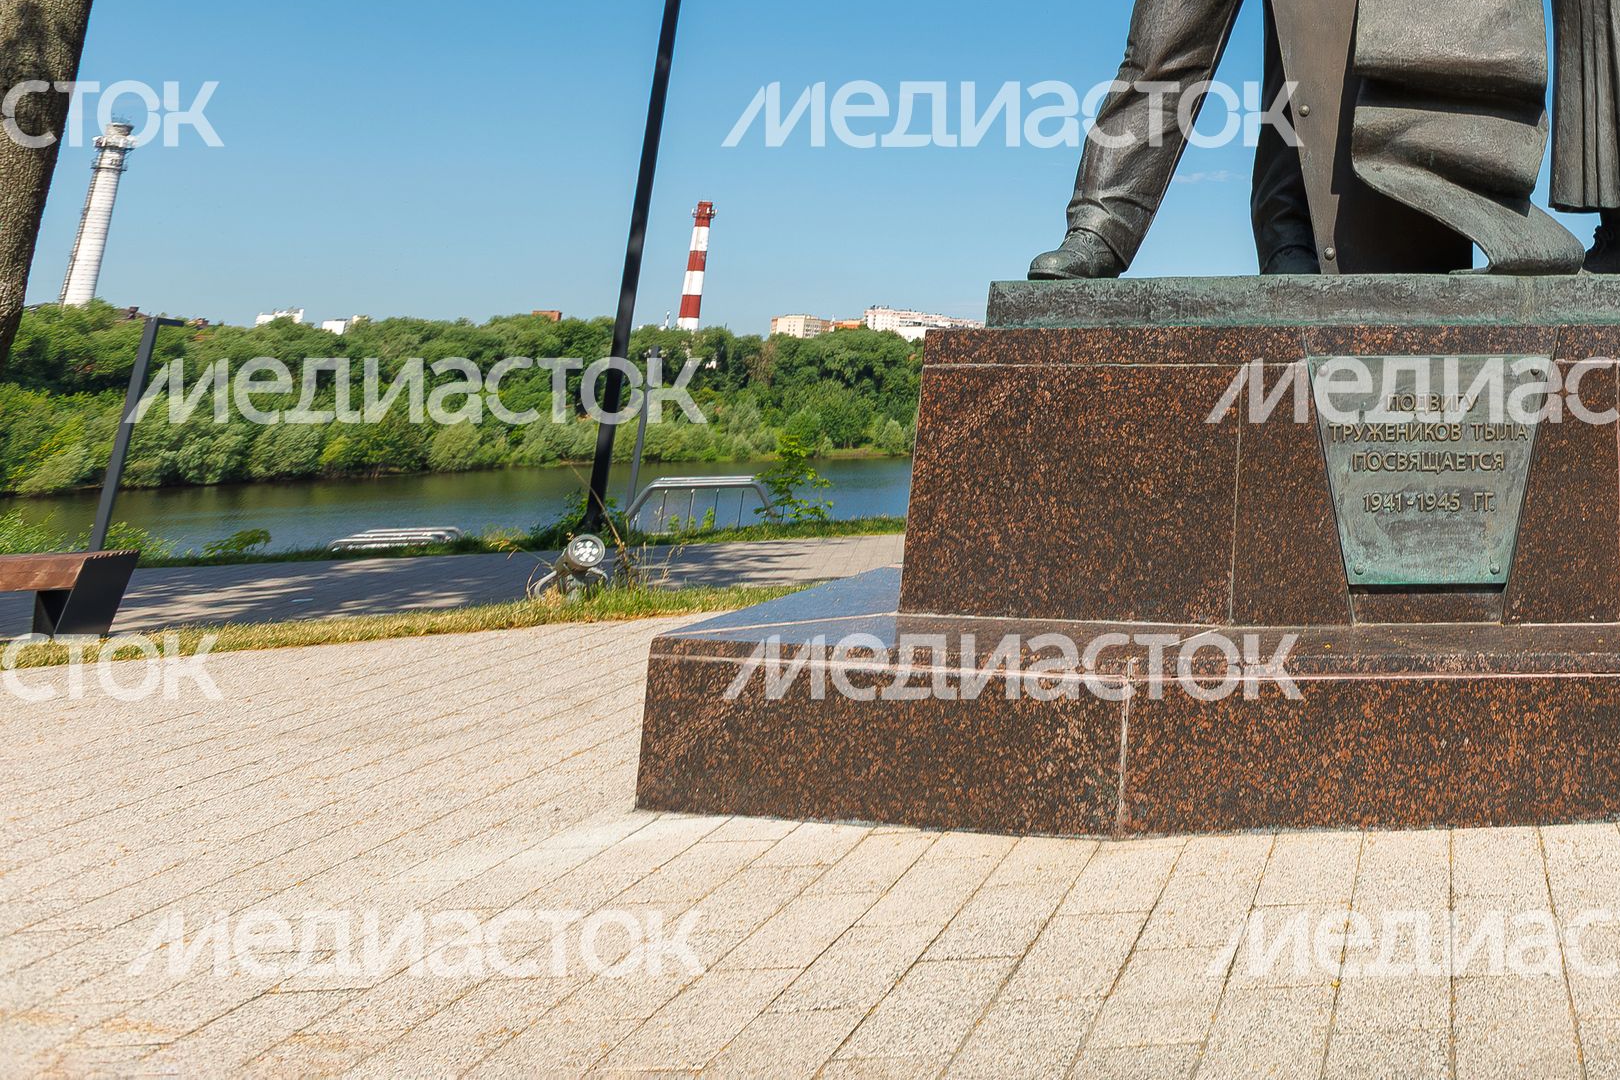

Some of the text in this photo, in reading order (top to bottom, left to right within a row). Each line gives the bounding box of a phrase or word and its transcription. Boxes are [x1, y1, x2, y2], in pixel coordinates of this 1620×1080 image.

[1329, 422, 1529, 442] ТРУЖЕНИКОВ ТЫЛА
[1351, 452, 1505, 474] ПОСВЯЩАЕТСЯ
[1363, 492, 1461, 512] 1941-1945
